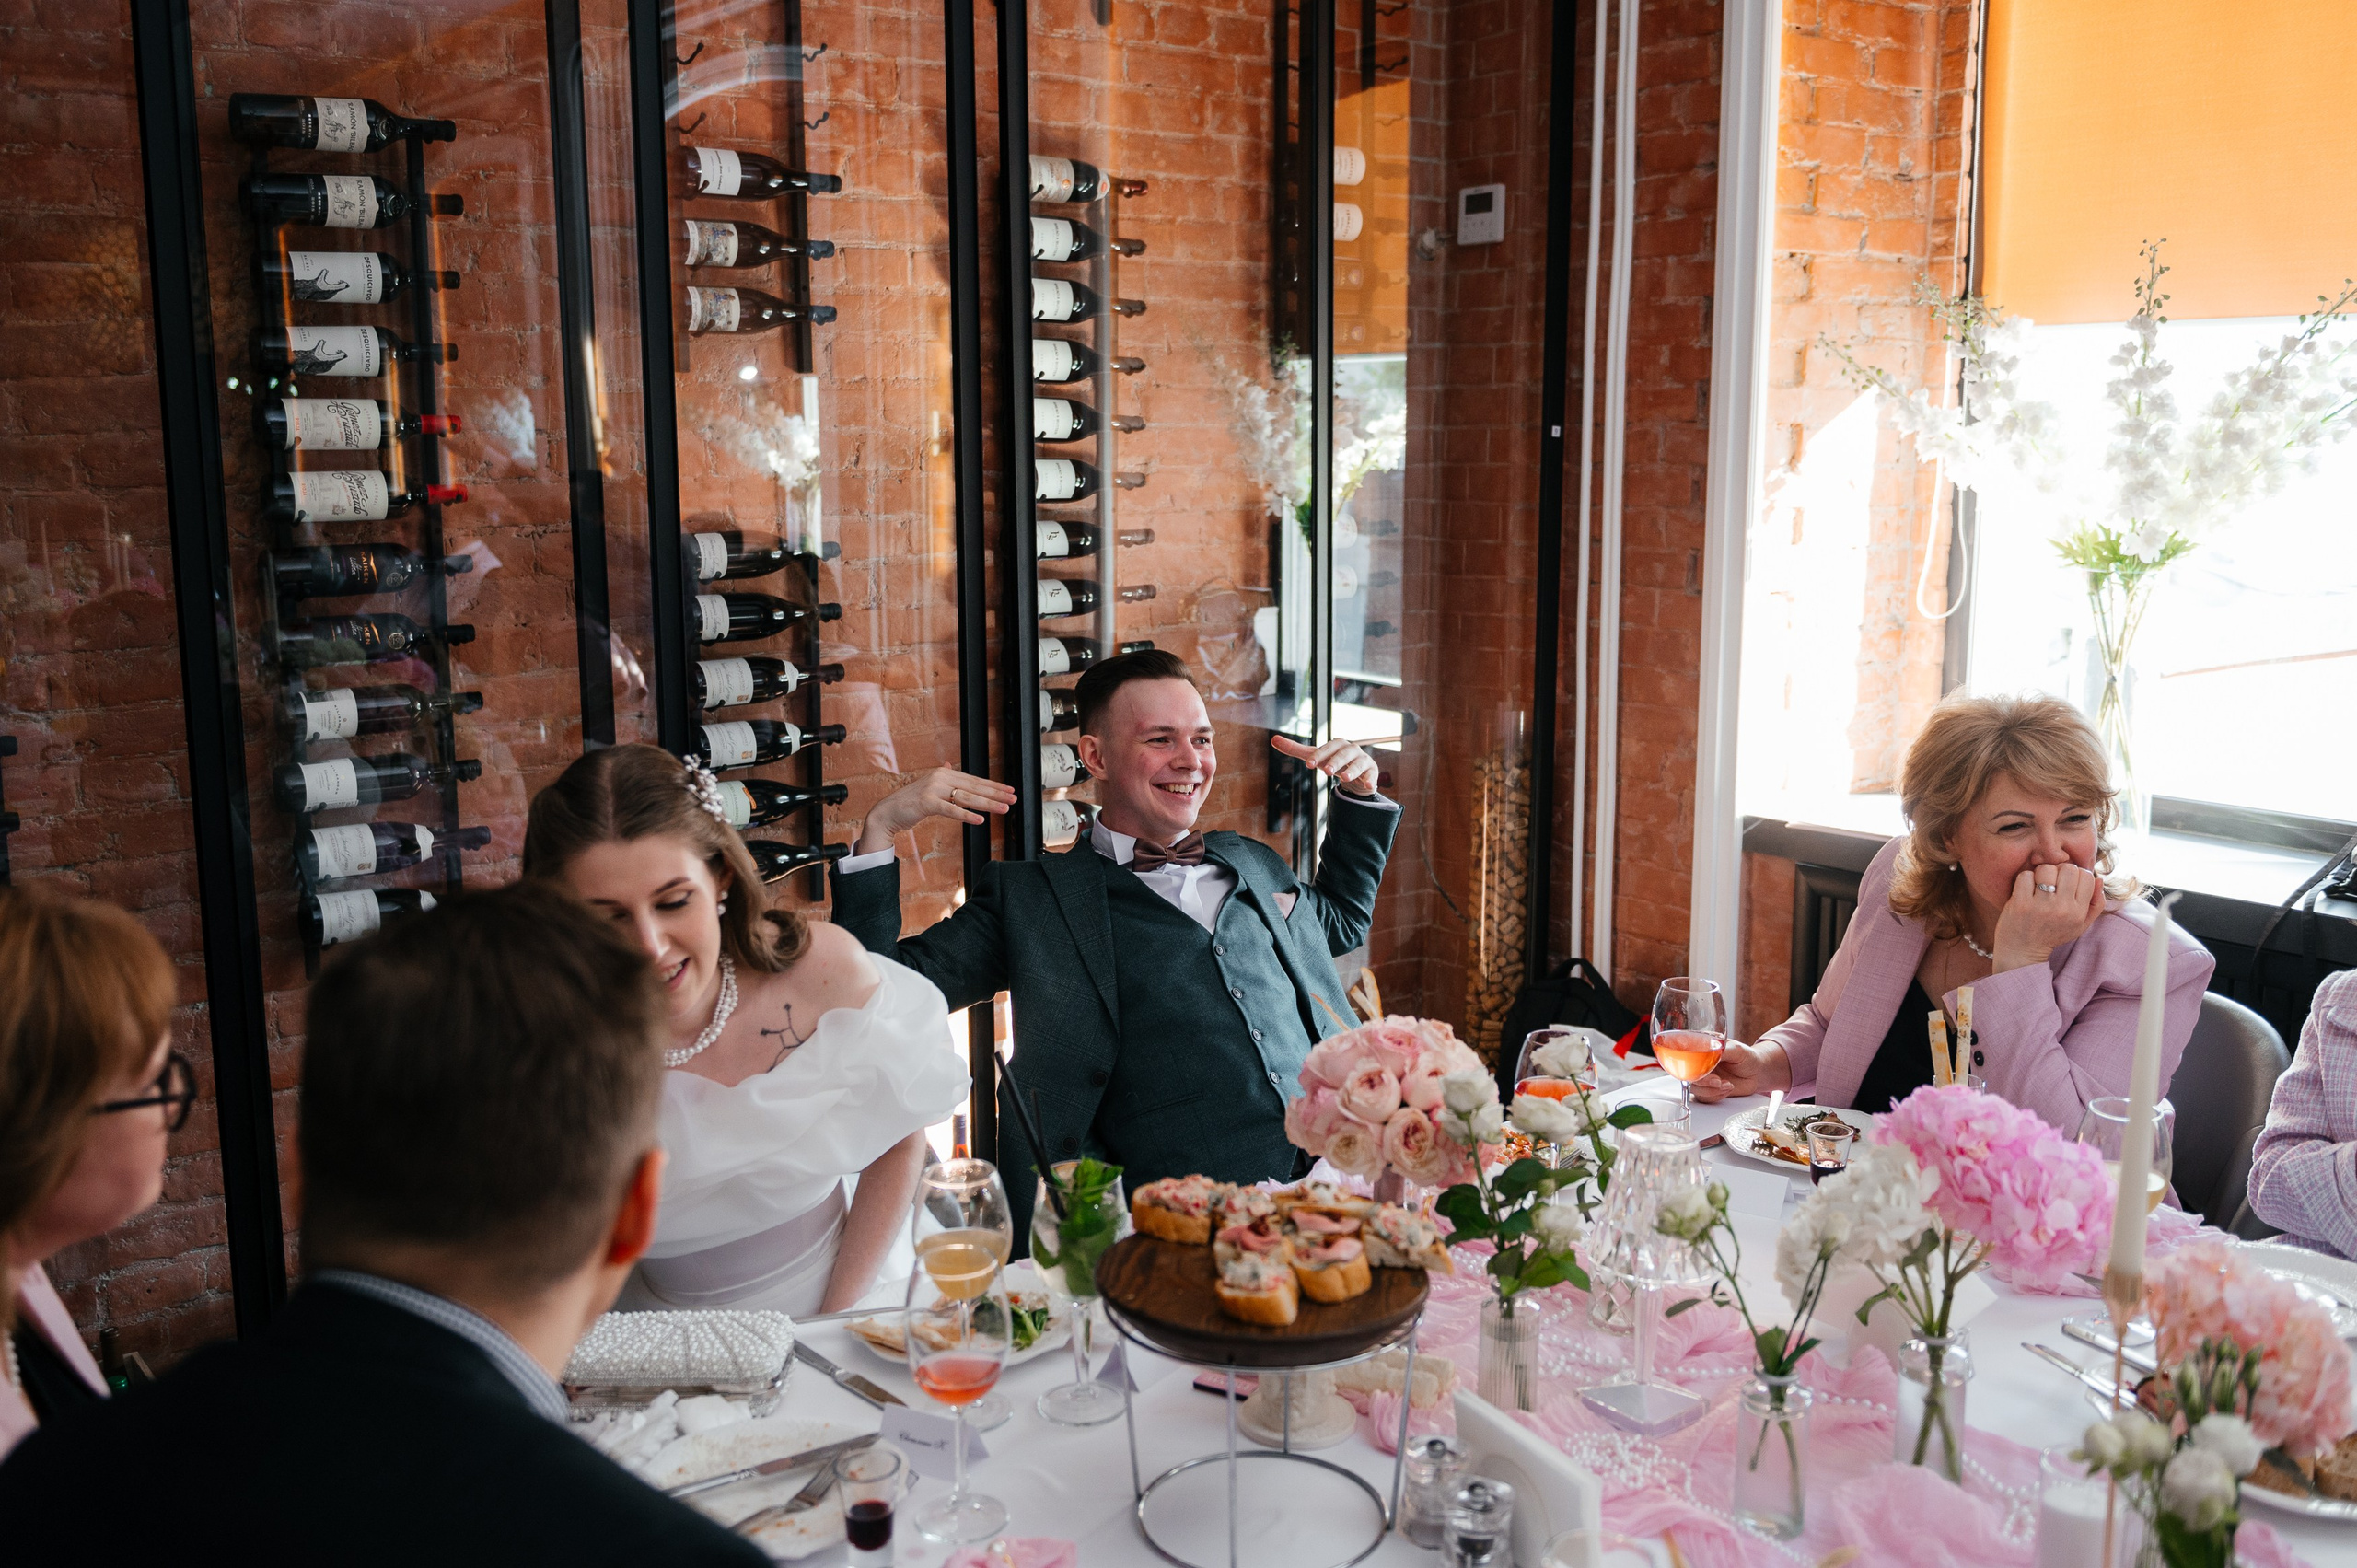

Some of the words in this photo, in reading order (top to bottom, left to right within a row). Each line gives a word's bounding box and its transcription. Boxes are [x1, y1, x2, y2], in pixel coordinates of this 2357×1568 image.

[348, 101, 357, 130] RAMÓN
[347, 131, 356, 152] BILBAO
[356, 180, 366, 207] RAMÓN
[361, 552, 369, 584] KAIKEN
